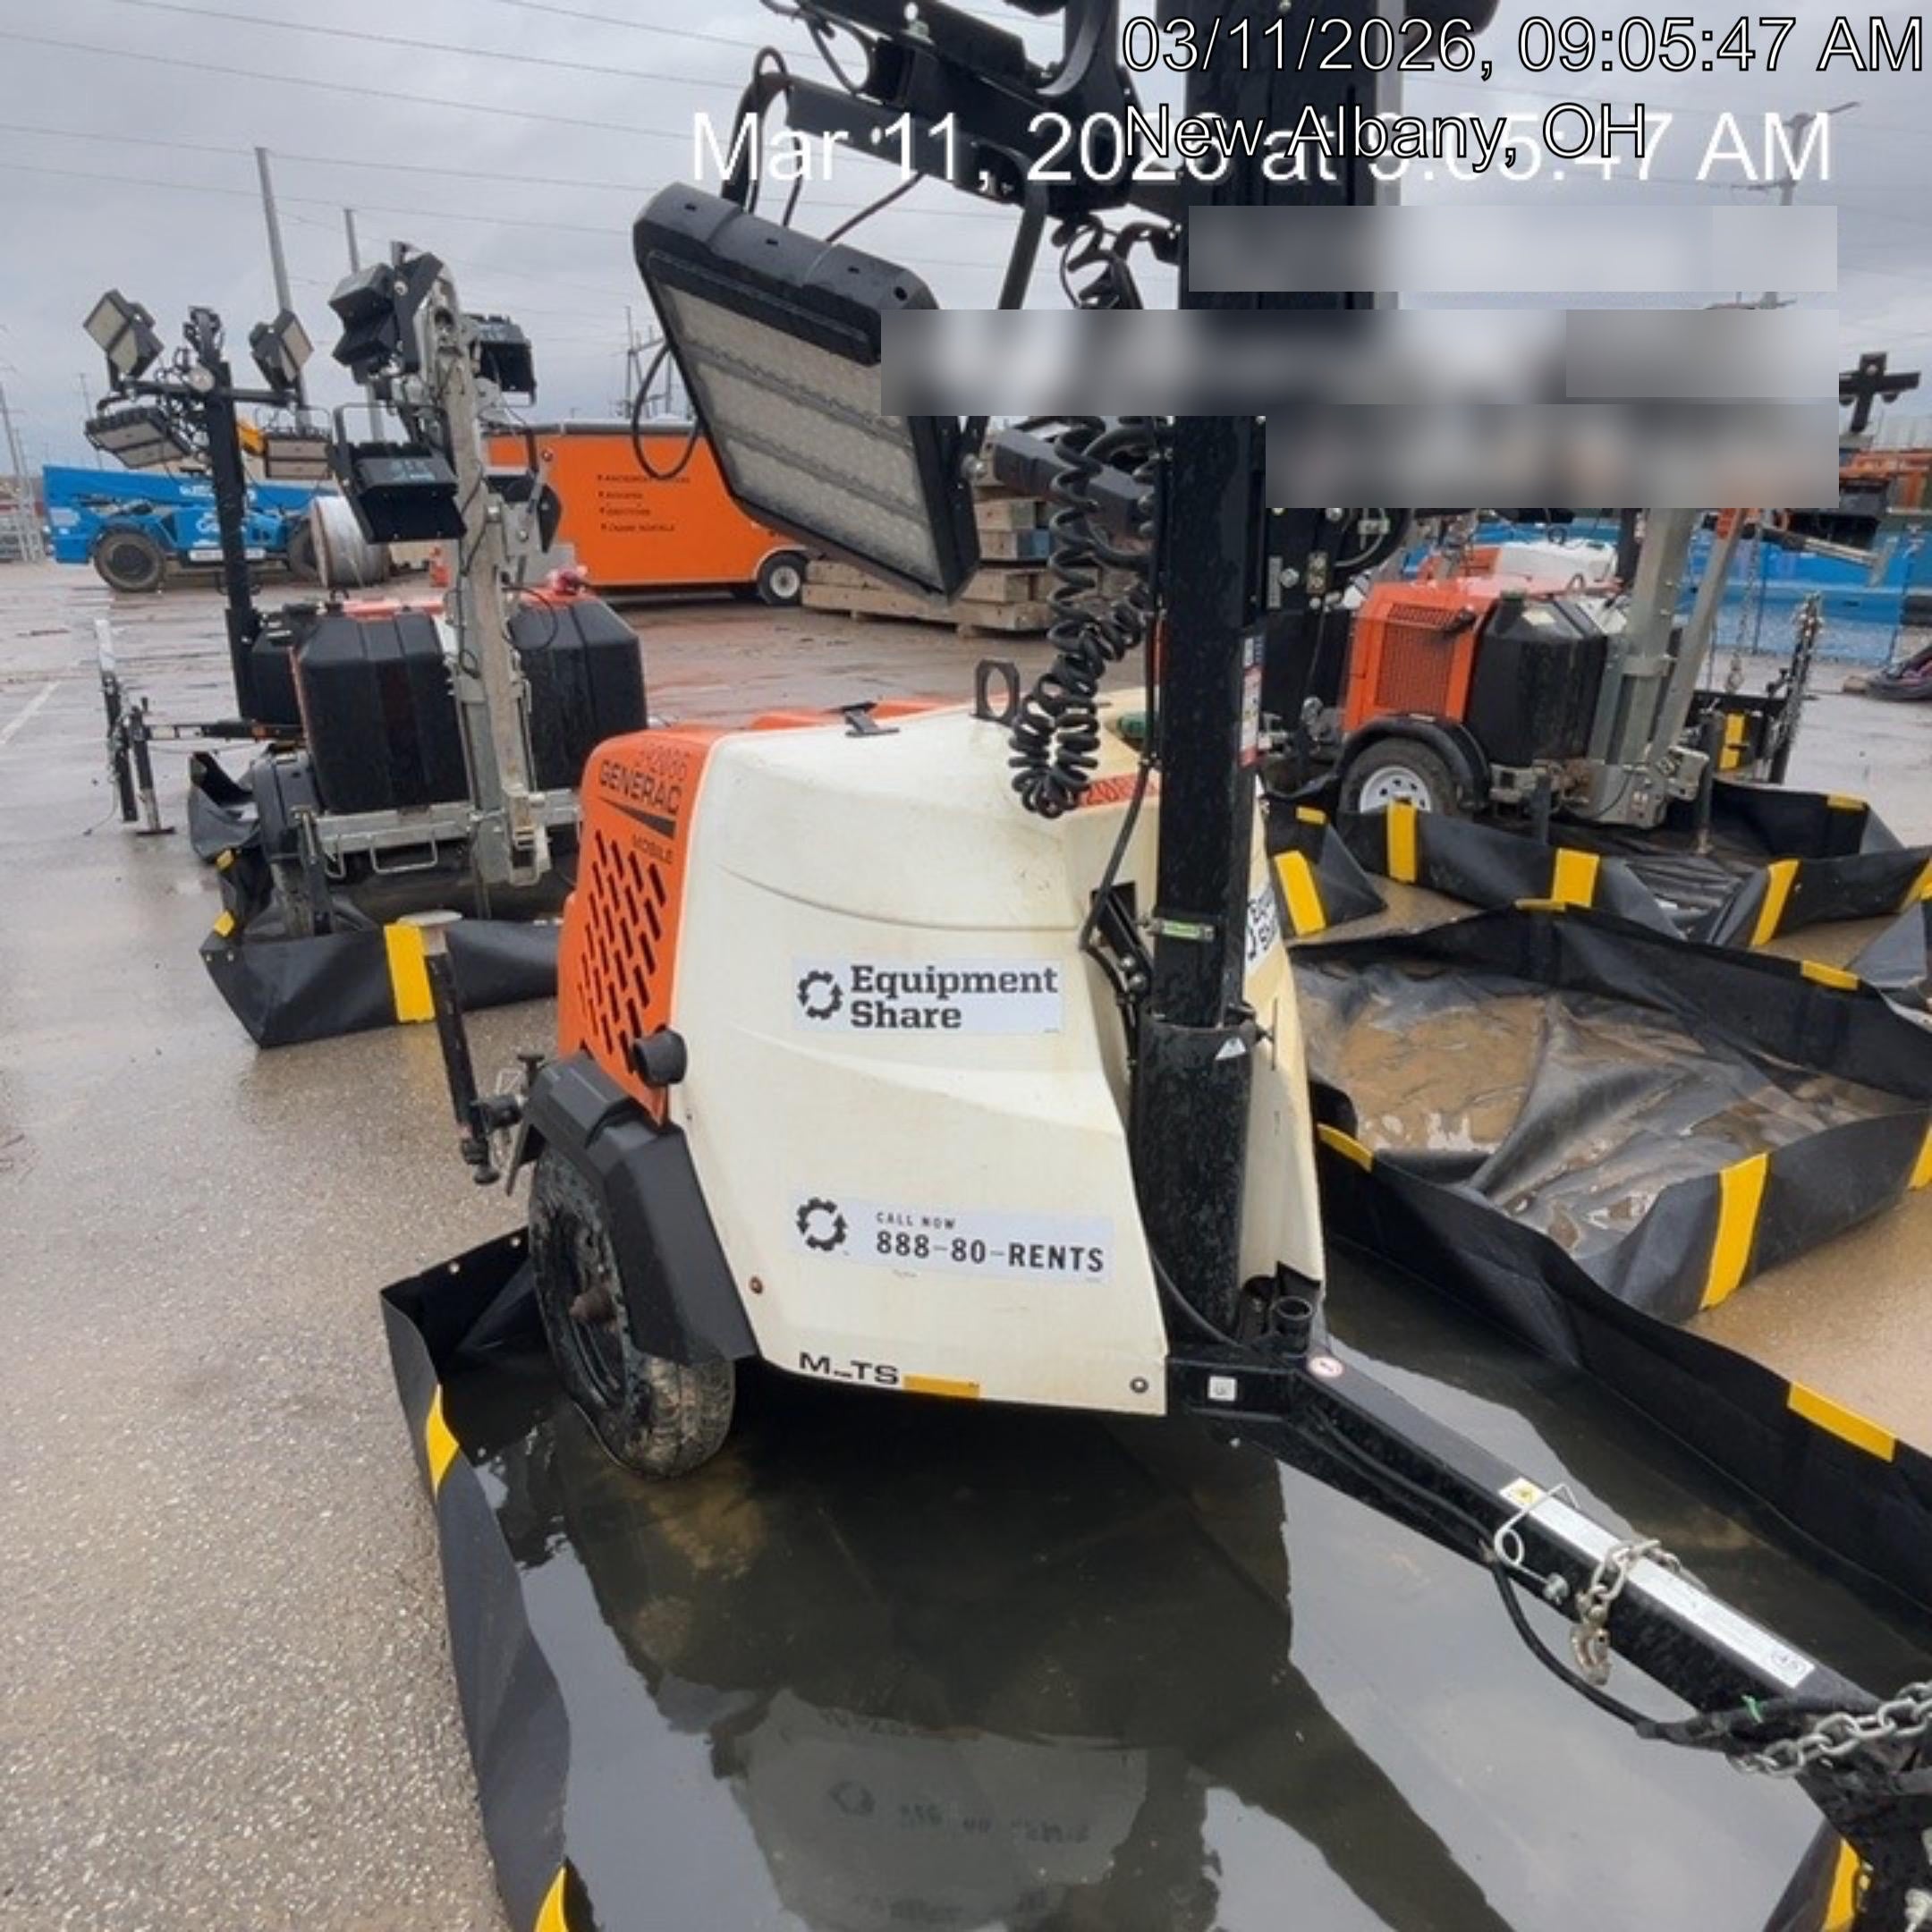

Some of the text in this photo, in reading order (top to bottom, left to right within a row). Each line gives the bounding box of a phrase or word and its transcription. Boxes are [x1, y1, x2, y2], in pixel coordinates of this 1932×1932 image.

[599, 758, 682, 816] GENERAC
[850, 964, 1059, 1001] Equipment
[850, 1000, 963, 1030] Share
[876, 1211, 956, 1231] CALL NOW
[876, 1230, 1105, 1274] 888-80-RENTS
